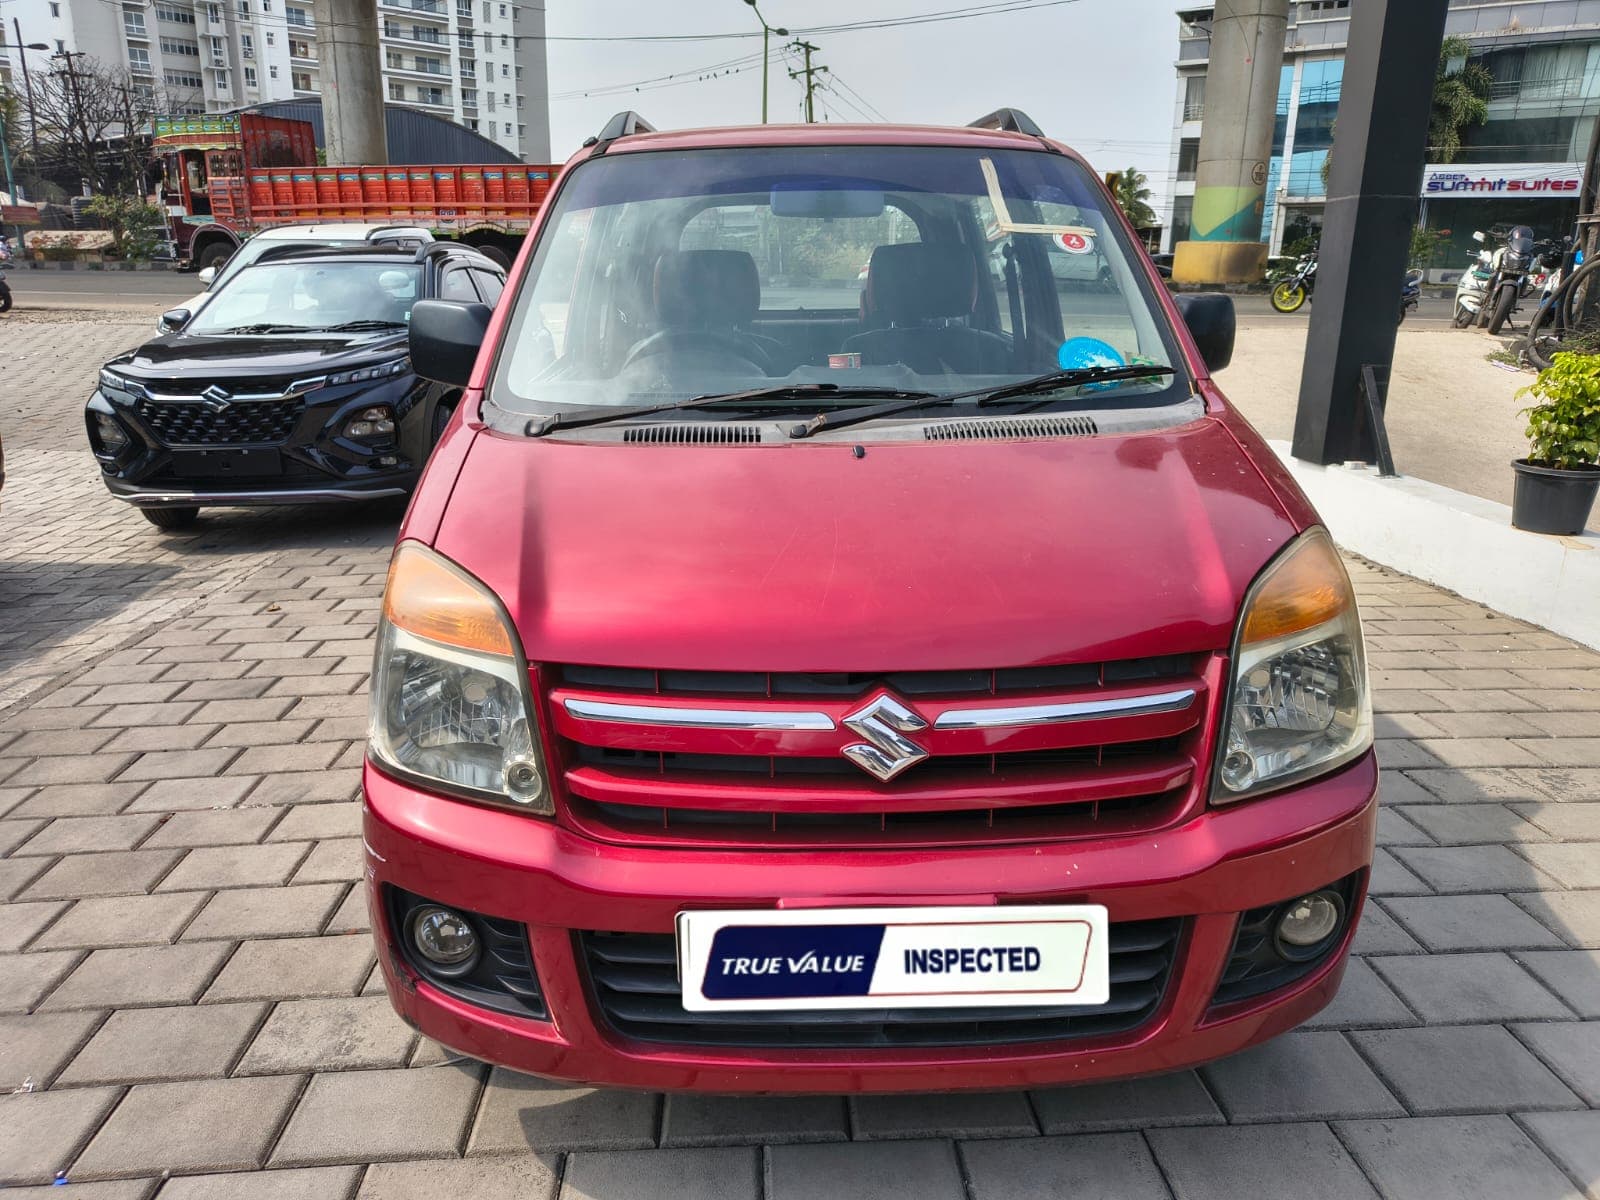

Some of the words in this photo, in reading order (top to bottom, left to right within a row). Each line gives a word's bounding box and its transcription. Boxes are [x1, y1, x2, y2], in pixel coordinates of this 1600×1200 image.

[722, 957, 783, 975] TRUE
[787, 950, 865, 974] VALUE
[904, 947, 1041, 974] INSPECTED
